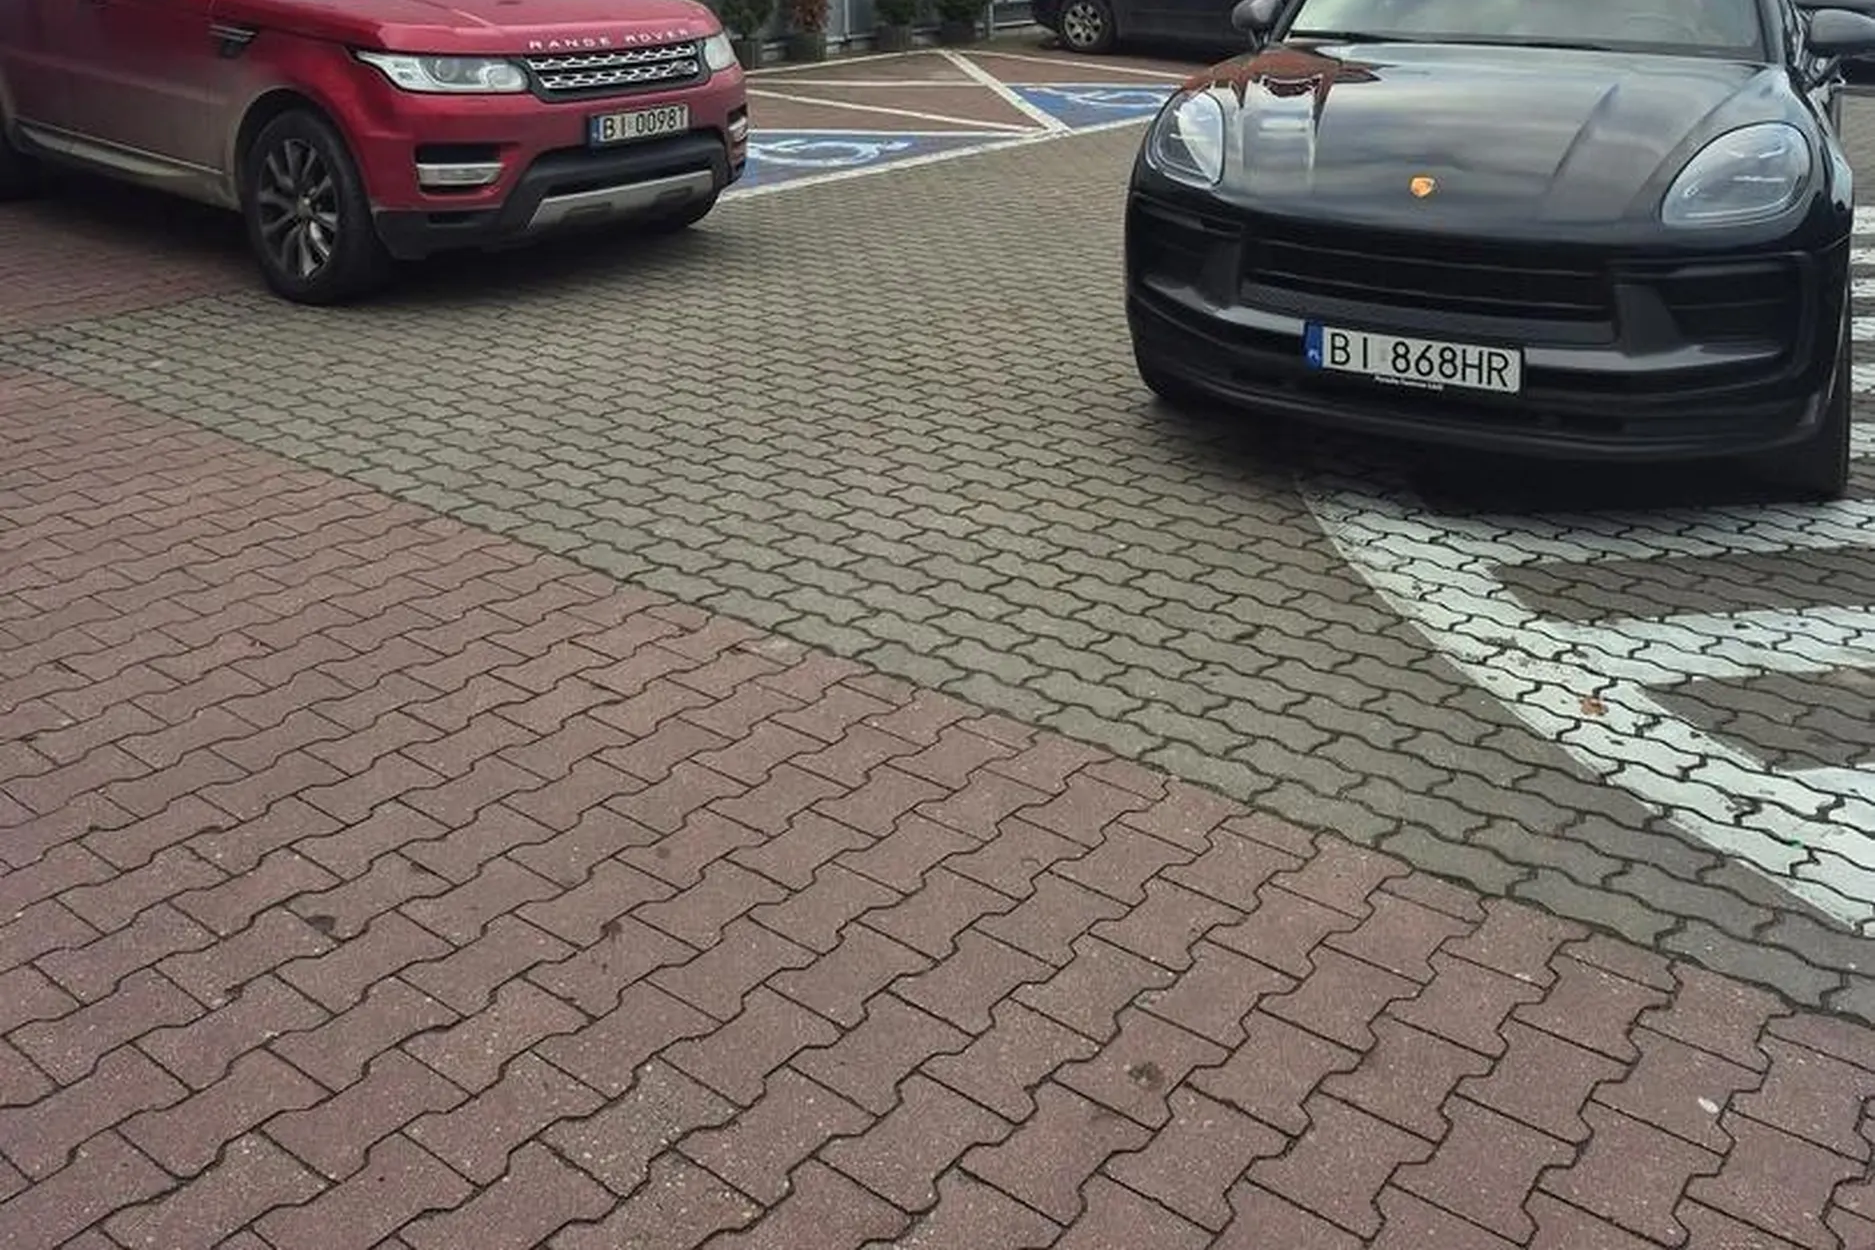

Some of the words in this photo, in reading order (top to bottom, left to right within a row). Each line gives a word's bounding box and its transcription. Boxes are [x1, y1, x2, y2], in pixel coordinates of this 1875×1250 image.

[529, 36, 611, 50] RANGE
[624, 28, 689, 45] ROVER
[603, 116, 626, 139] BI
[1330, 332, 1368, 370] BI
[1391, 341, 1509, 388] 868HR
